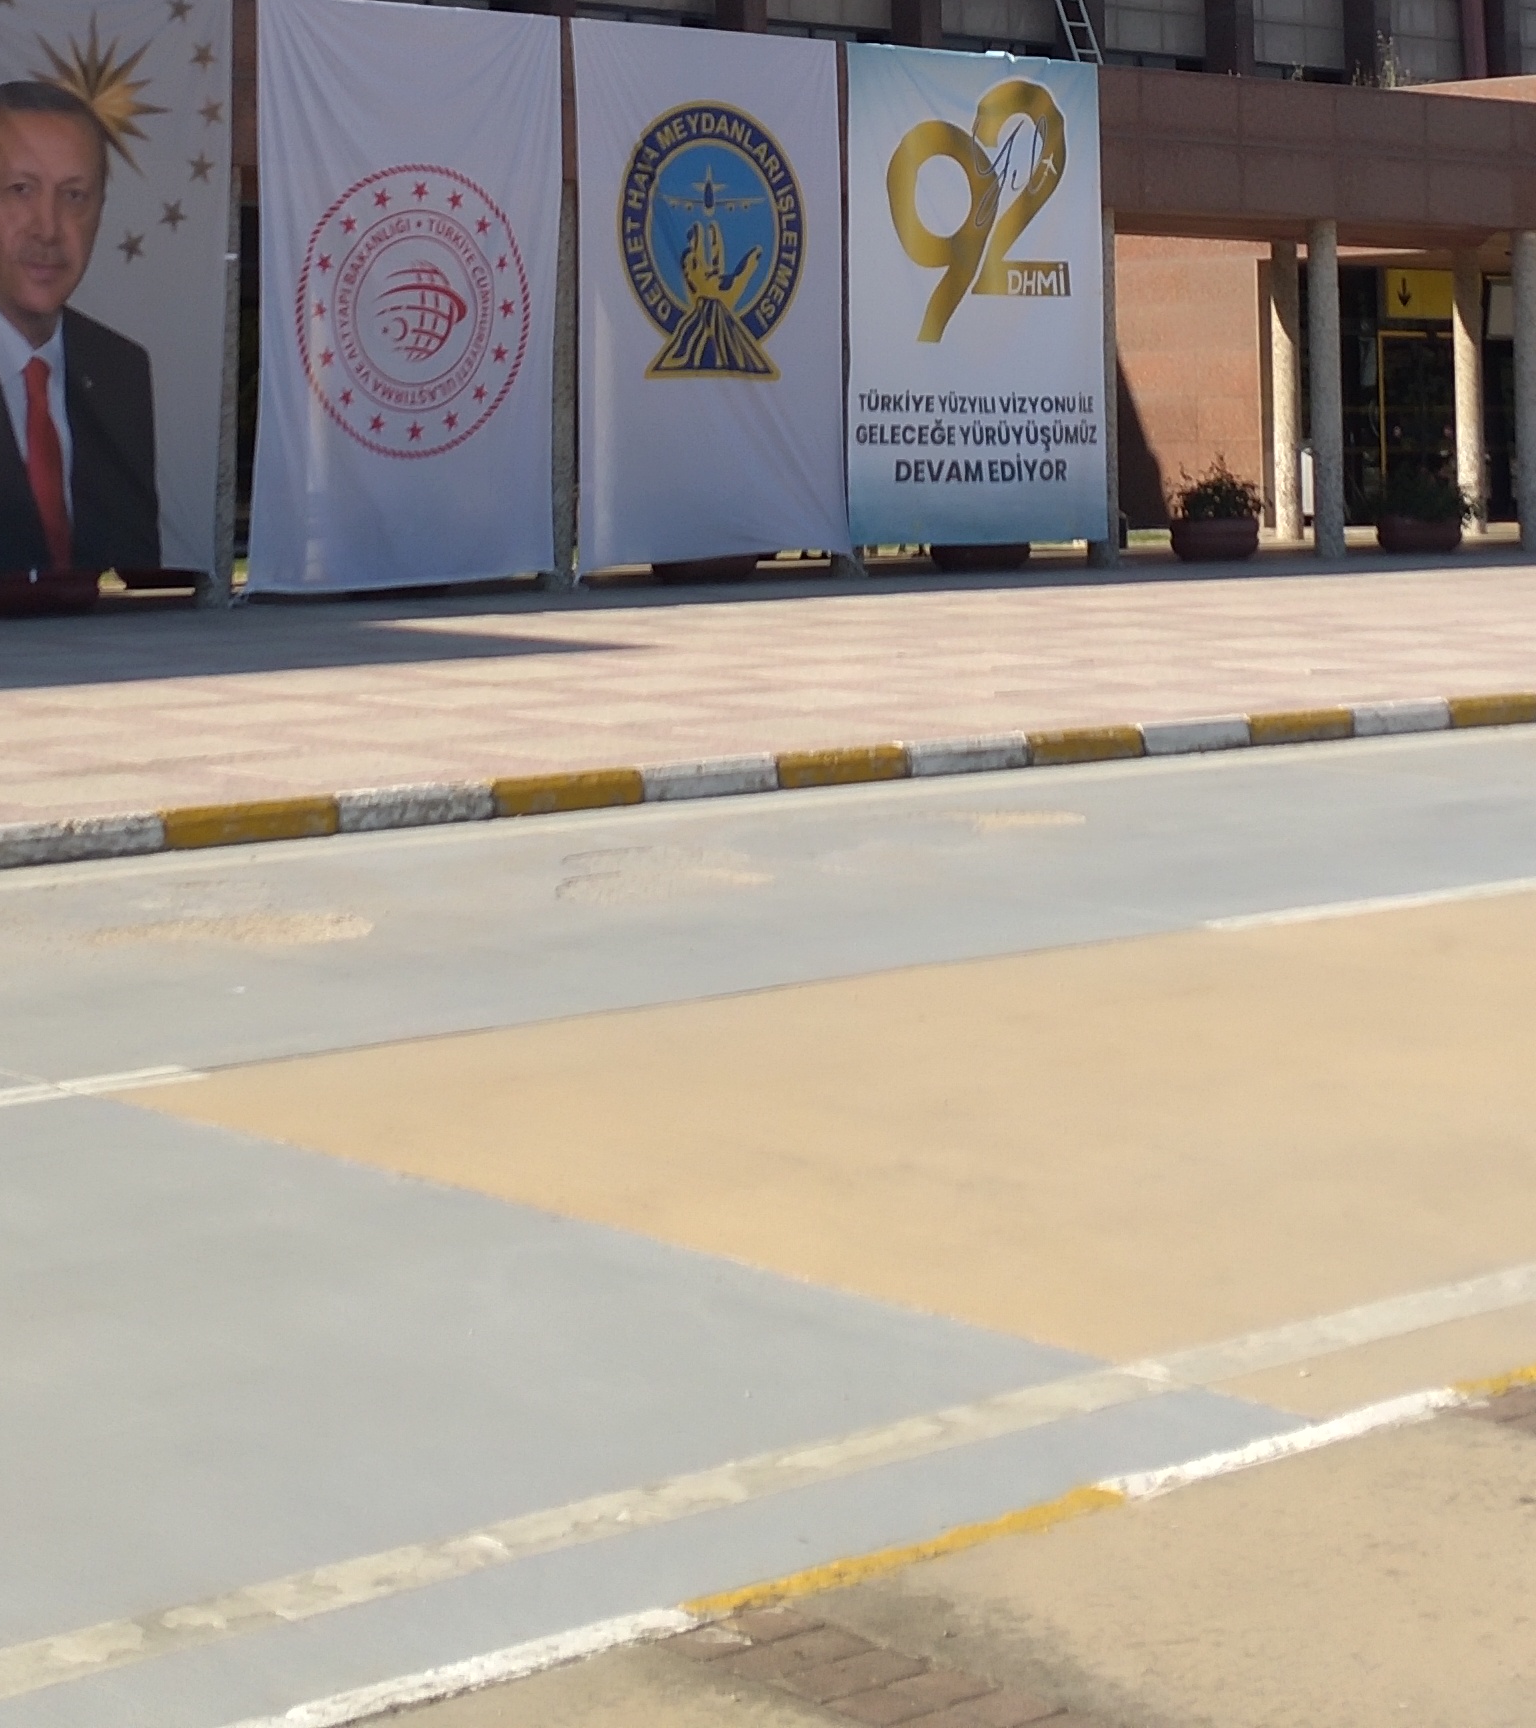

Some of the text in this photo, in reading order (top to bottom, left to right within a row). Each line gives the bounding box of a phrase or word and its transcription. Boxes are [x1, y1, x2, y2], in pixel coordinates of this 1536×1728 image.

[656, 112, 784, 185] MEYDANLARI
[627, 139, 660, 211] HAVA
[626, 216, 672, 321] DEVLET
[1007, 263, 1066, 296] DHMİ
[858, 388, 1094, 414] TÜRKİYE YÜZYILI VİZYONU İLE
[855, 419, 1098, 453] GELECEĞE YÜRÜYÜŞÜMÜZ
[894, 453, 1068, 483] DEVAM EDİYOR
